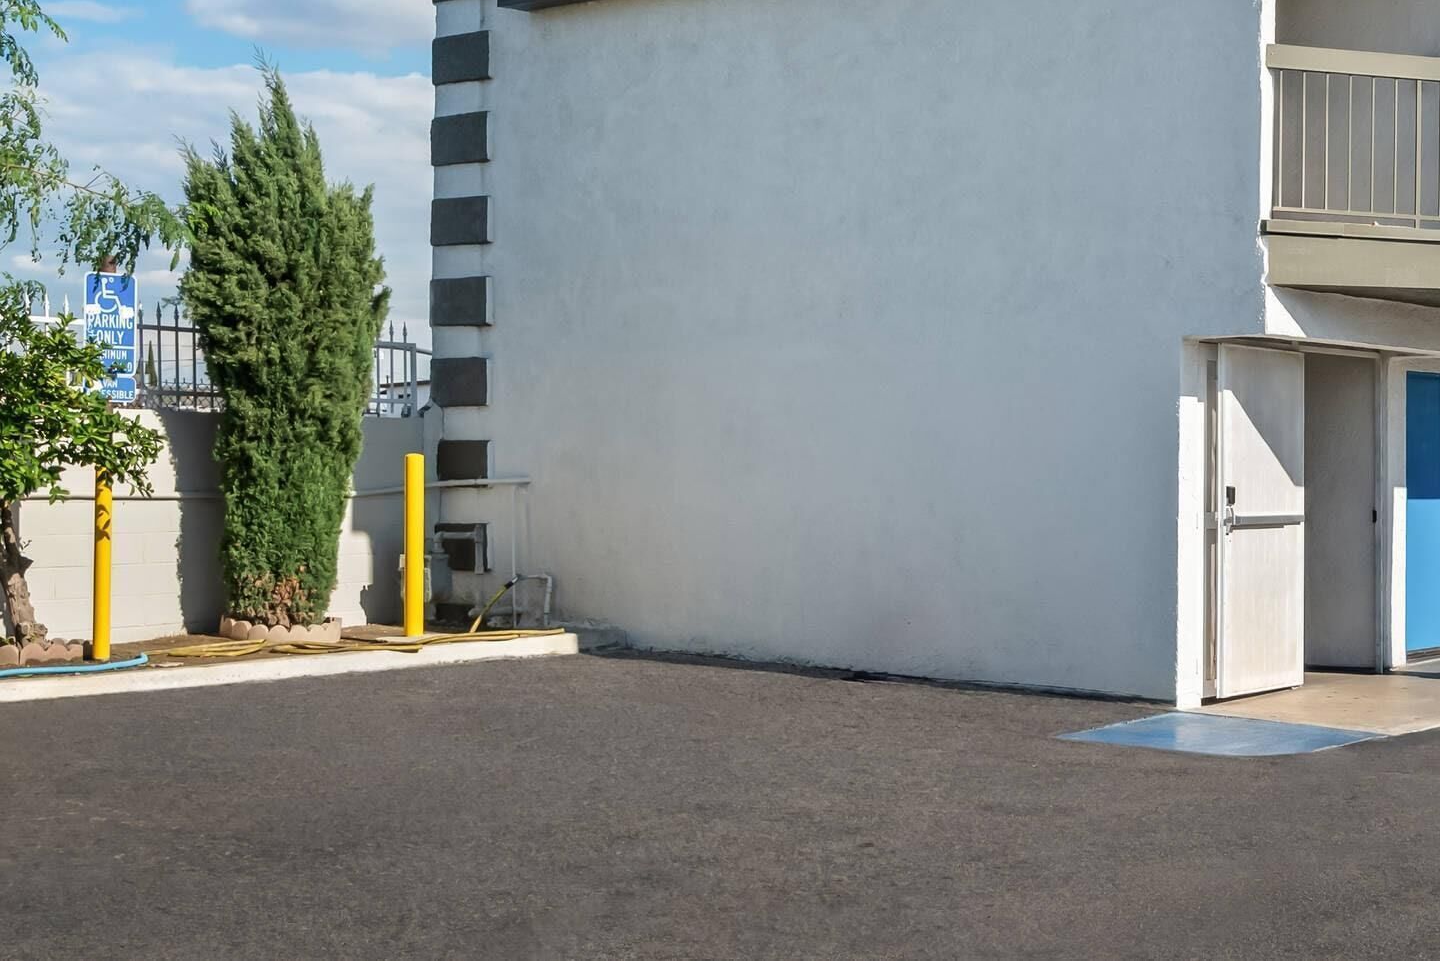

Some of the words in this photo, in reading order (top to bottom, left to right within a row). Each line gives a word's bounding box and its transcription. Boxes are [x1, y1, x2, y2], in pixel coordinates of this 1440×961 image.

[88, 313, 133, 329] PARKING
[96, 330, 124, 345] ONLY
[102, 349, 127, 360] NIMUM
[100, 390, 134, 400] ESSIBLE
